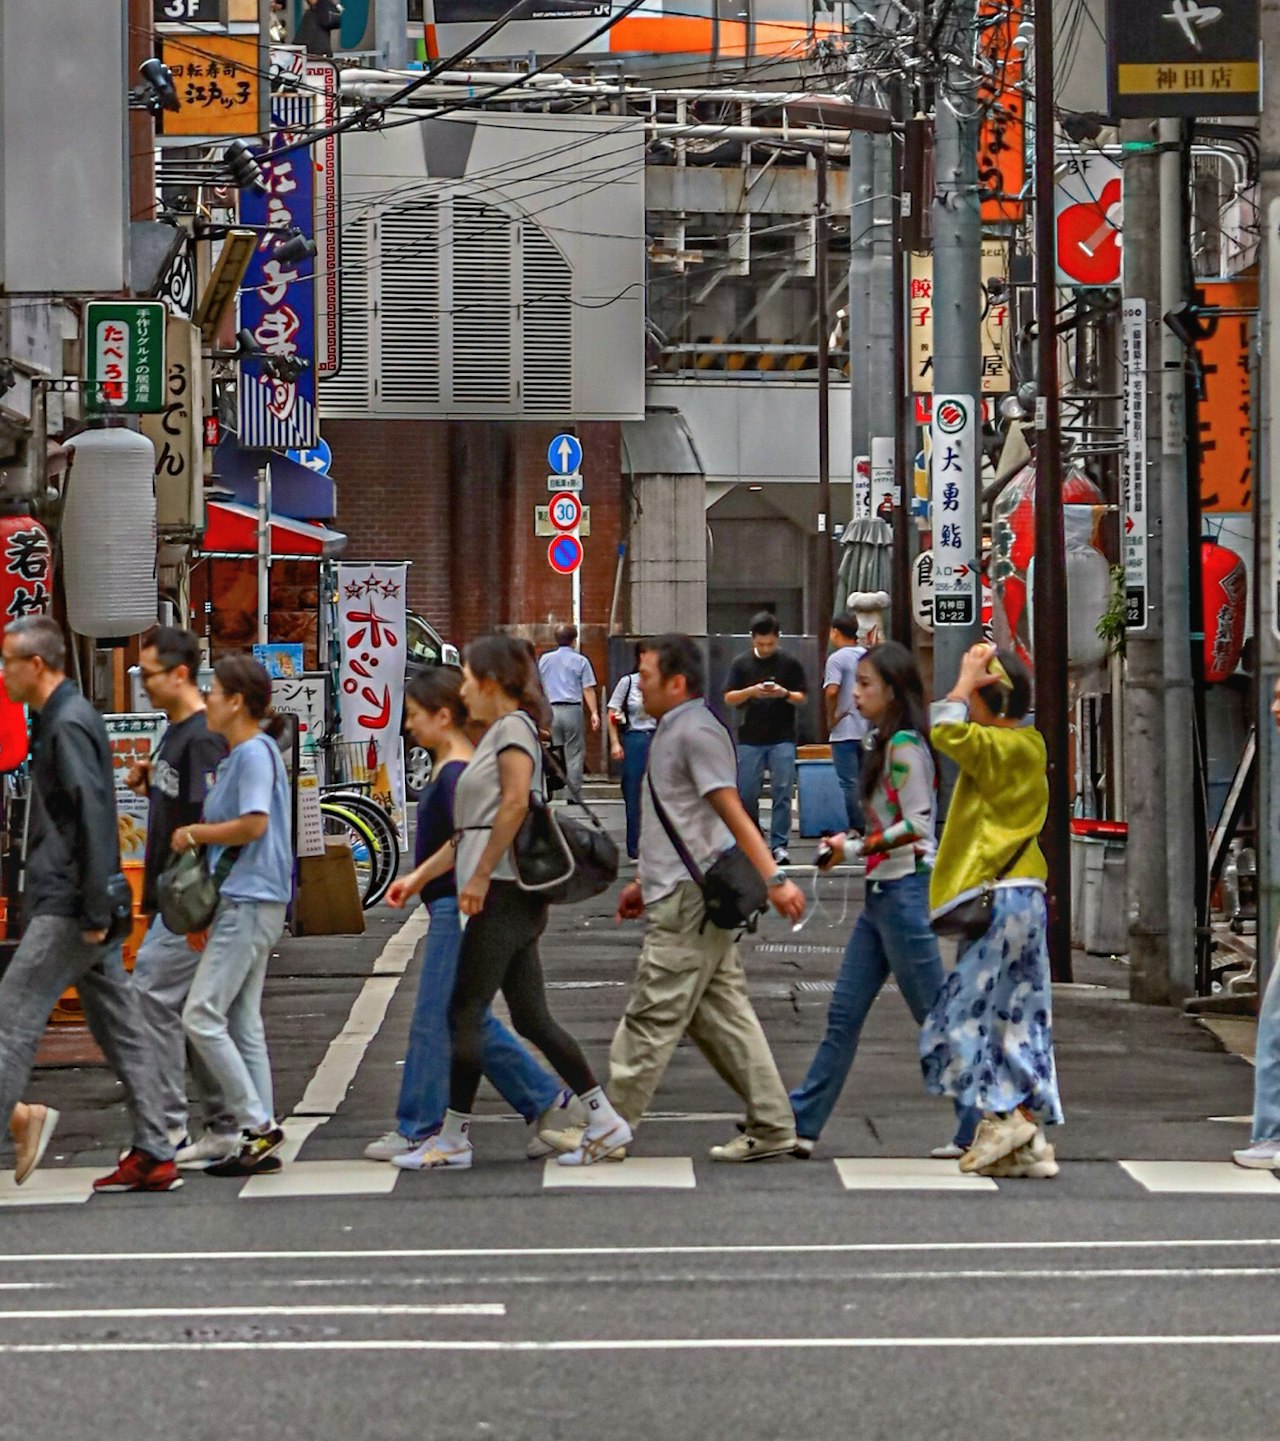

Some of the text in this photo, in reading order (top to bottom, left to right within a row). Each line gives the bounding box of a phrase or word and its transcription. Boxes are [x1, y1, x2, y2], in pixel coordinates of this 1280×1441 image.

[1156, 67, 1232, 90] 神田店
[941, 447, 962, 549] 大勇鮨
[556, 504, 575, 521] 30
